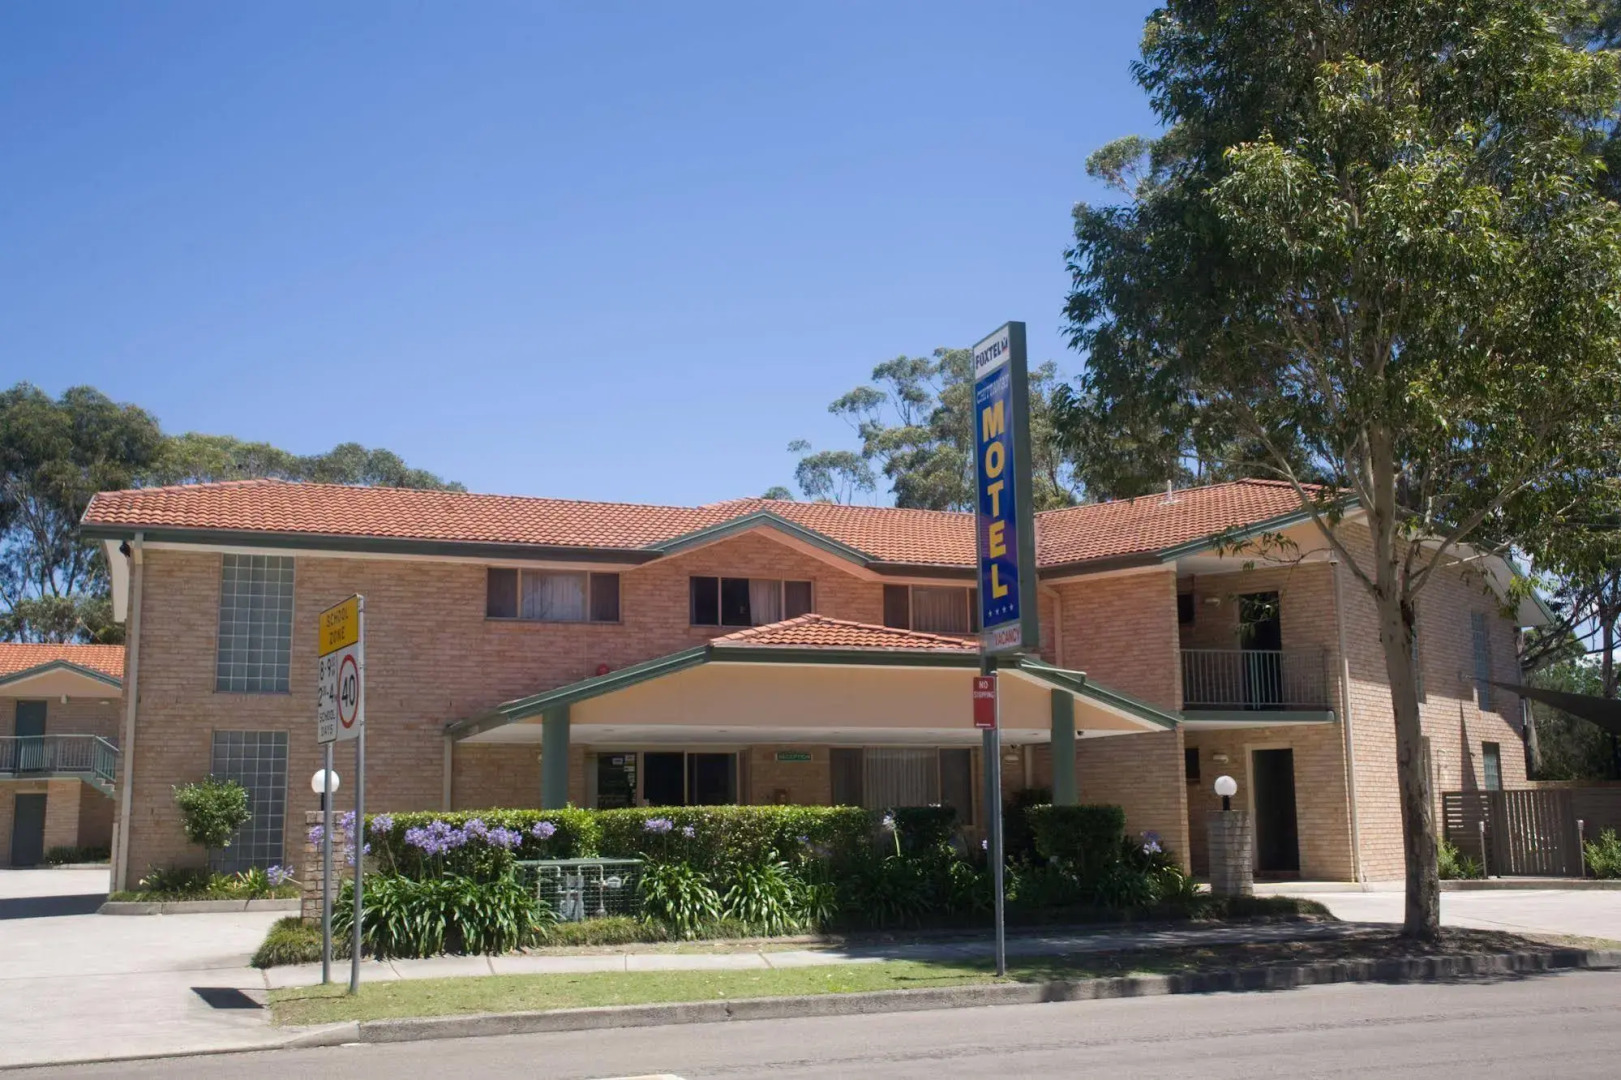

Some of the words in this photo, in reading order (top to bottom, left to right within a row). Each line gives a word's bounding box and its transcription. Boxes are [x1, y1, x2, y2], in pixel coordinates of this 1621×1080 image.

[975, 341, 1002, 370] FOXTEL
[982, 399, 1008, 599] MOTEL
[326, 606, 349, 628] SCHOOL
[329, 625, 345, 646] ZONE
[341, 674, 356, 708] 40
[978, 680, 989, 689] NO
